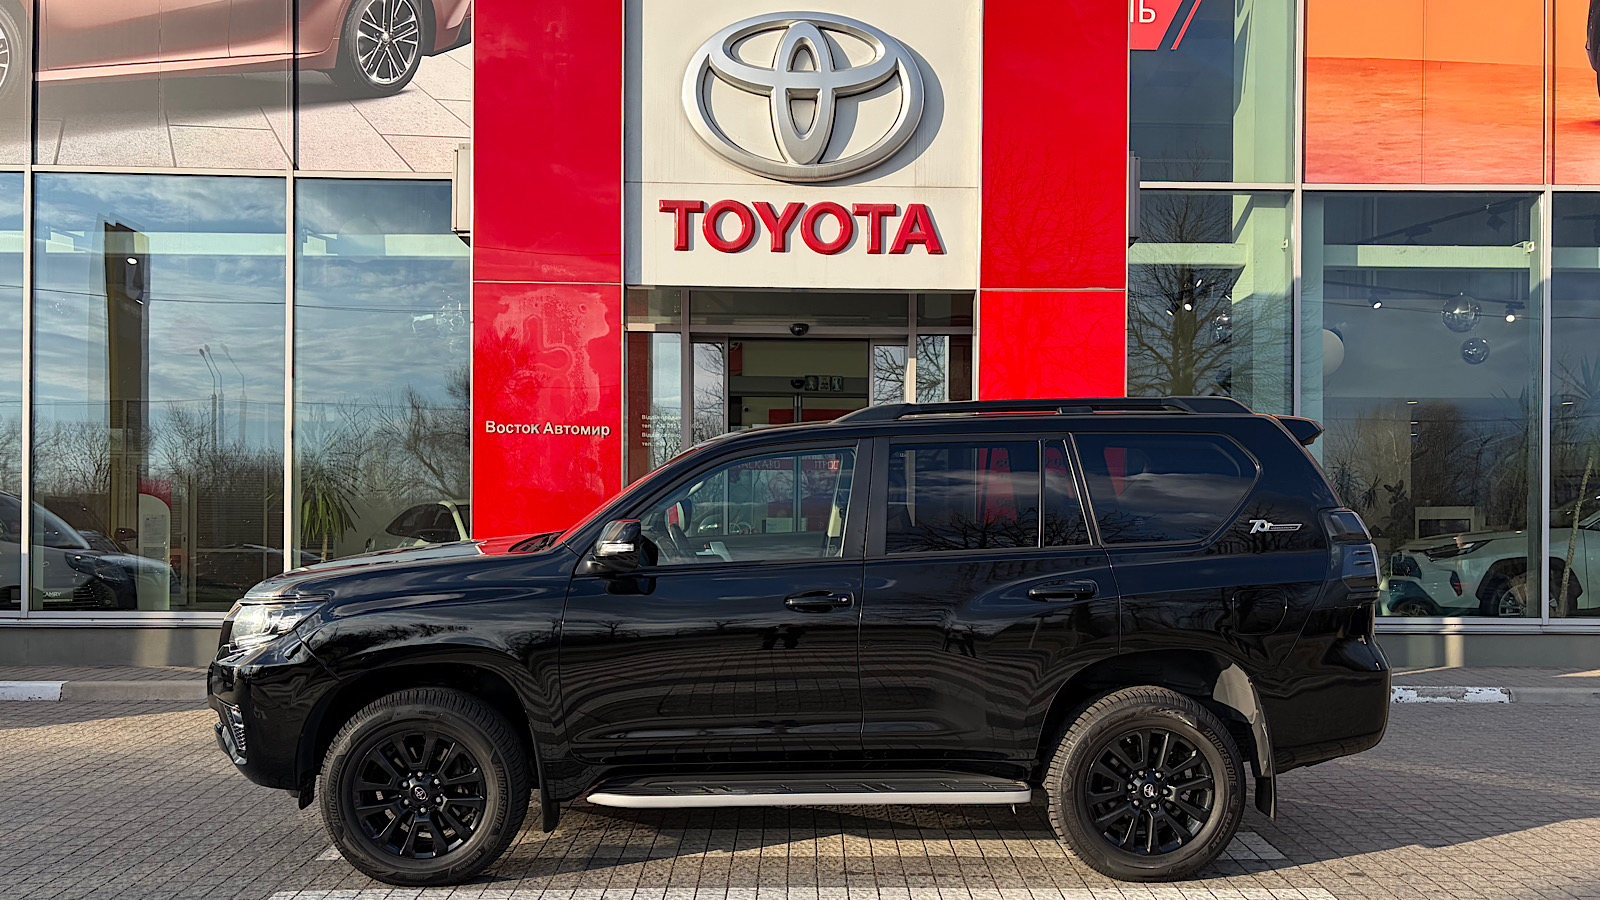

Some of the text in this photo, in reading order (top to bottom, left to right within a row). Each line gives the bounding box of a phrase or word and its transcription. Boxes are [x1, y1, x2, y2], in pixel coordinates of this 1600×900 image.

[659, 199, 945, 255] TOYOTA
[485, 420, 611, 438] Восток Автомир
[1202, 726, 1237, 786] BRIDGESTONE
[494, 761, 508, 830] BRIDGESTONE
